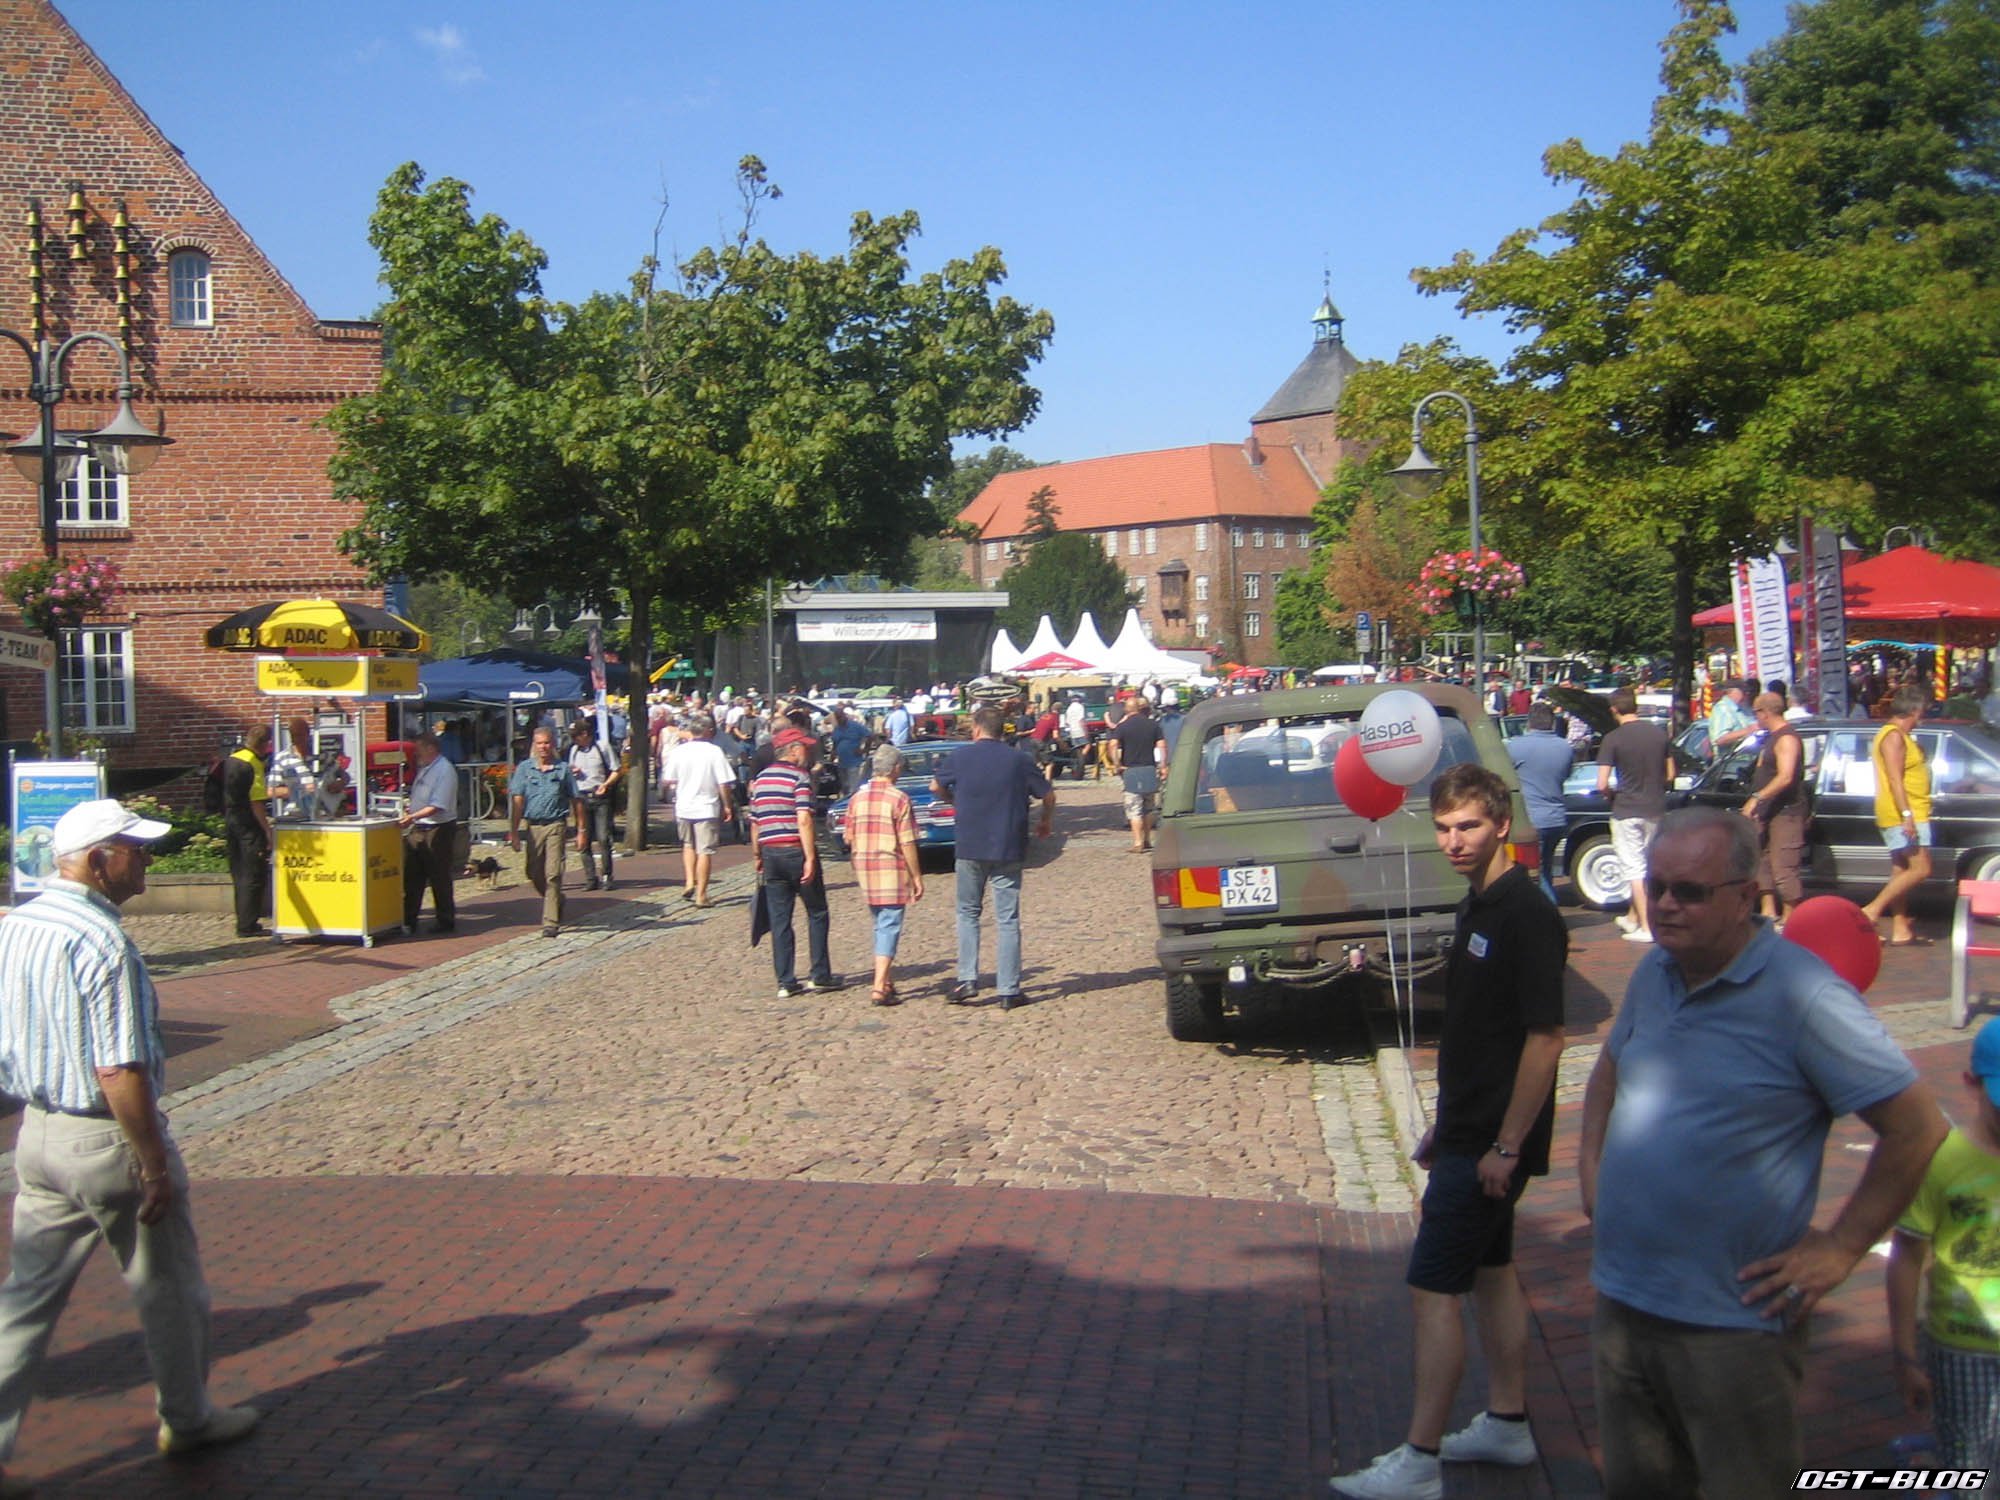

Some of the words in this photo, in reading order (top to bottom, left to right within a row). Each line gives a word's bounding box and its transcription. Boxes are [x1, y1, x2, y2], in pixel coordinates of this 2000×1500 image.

[284, 628, 328, 645] ADAC
[368, 630, 402, 647] ADAC
[1233, 870, 1256, 887] SE
[1226, 888, 1248, 904] PX
[1252, 886, 1272, 903] 42
